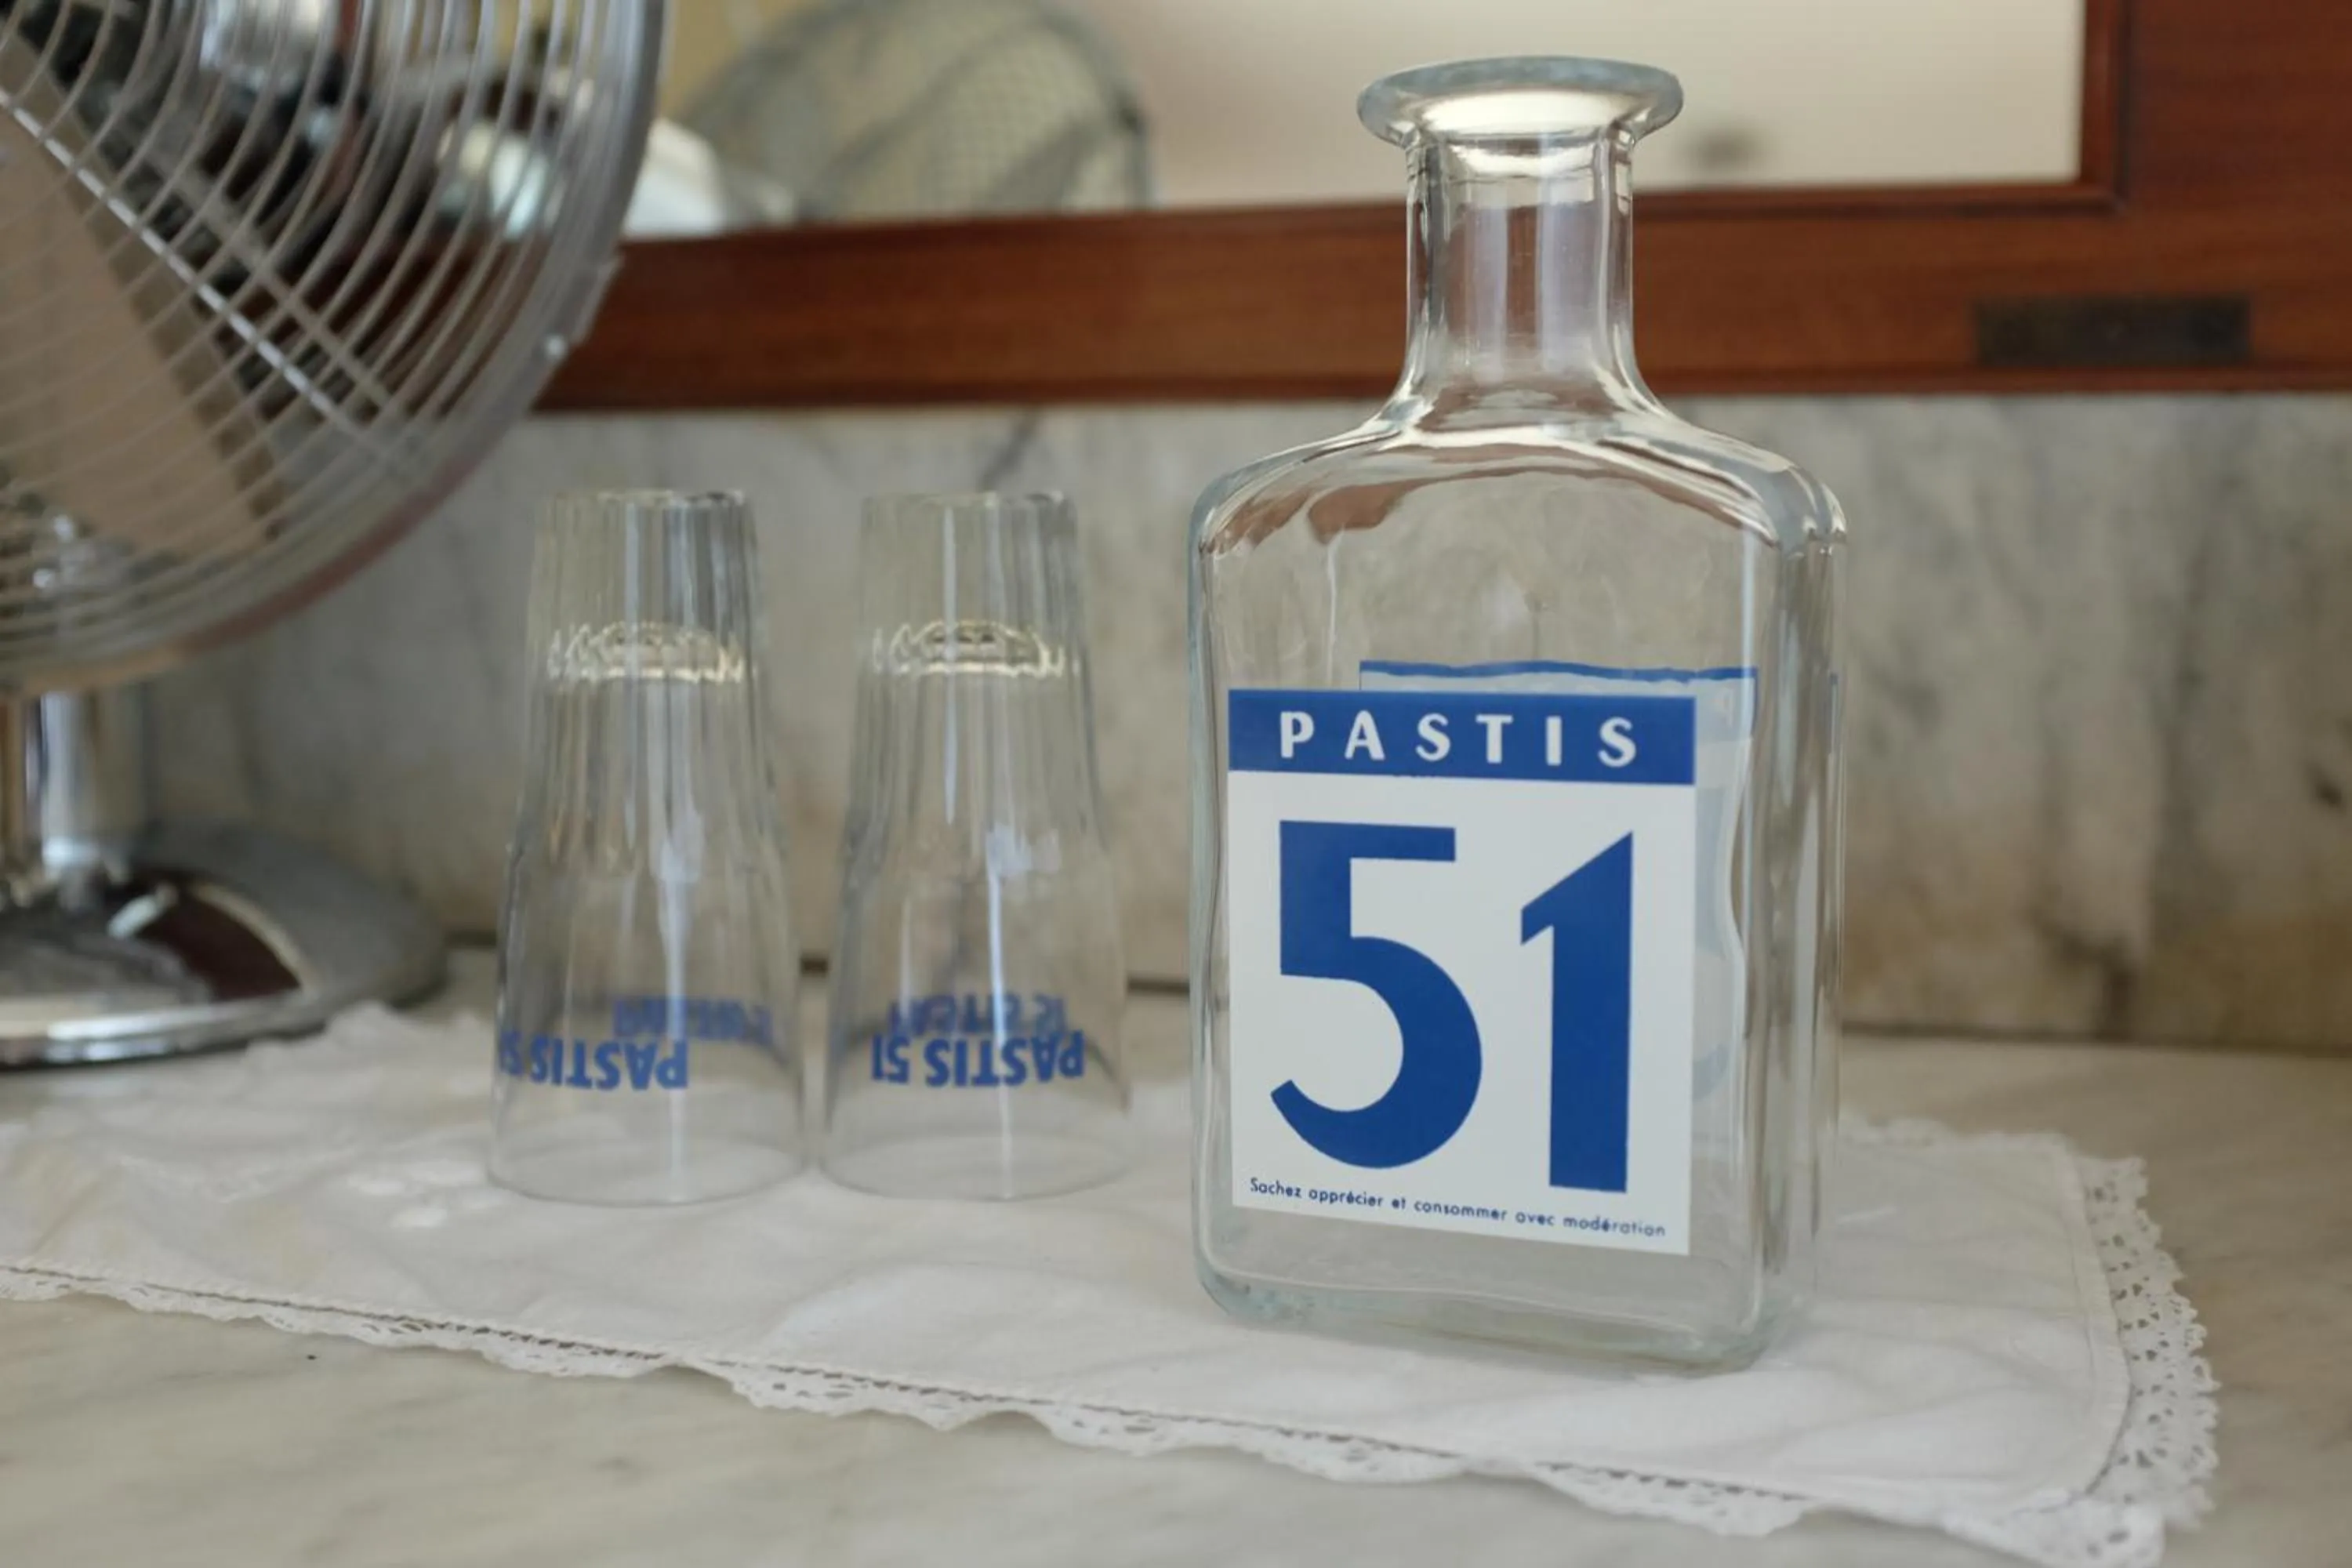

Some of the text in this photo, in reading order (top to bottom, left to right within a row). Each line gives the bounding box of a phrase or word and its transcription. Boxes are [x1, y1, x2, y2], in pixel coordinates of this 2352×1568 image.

[1279, 710, 1636, 768] PASTIS
[1270, 819, 1634, 1194] 51
[529, 1035, 689, 1091] PASTIS
[871, 1029, 1085, 1088] PASTIS 51
[1250, 1177, 1302, 1199] Sachez
[1308, 1188, 1383, 1207] apprécier
[1391, 1196, 1406, 1210] et
[1413, 1199, 1507, 1221] consommer
[1515, 1210, 1555, 1227] avec
